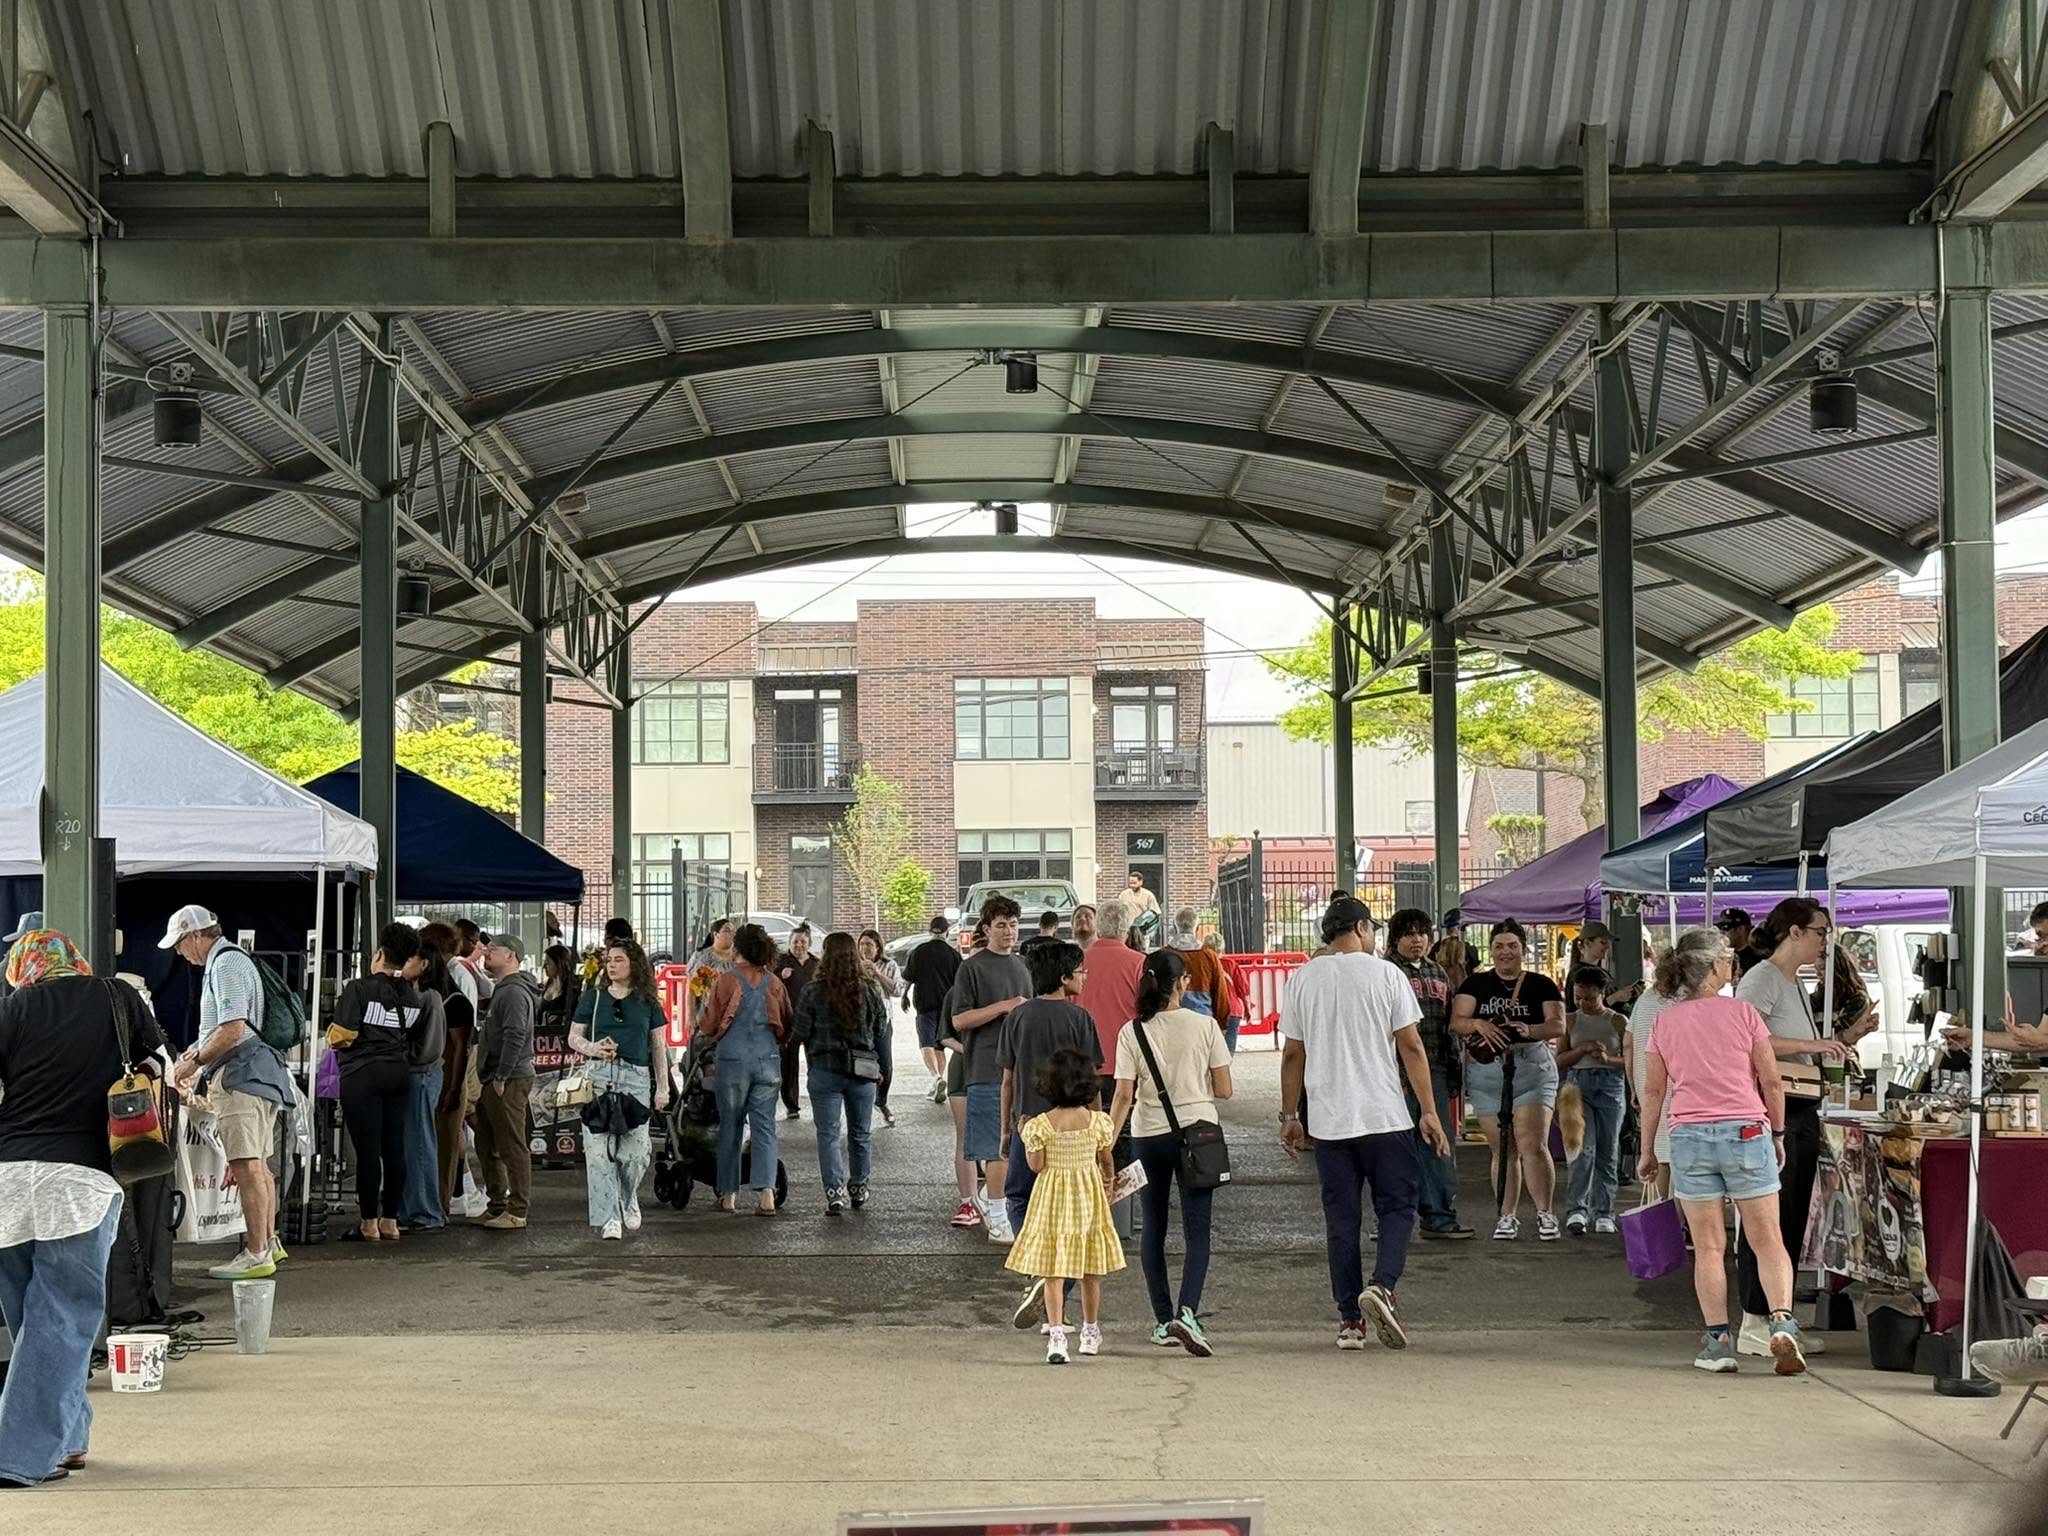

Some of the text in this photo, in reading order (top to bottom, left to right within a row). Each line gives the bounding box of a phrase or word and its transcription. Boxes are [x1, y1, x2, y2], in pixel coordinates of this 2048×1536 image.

[55, 819, 81, 834] R20
[1136, 838, 1155, 849] 567
[1689, 875, 1721, 884] MASER
